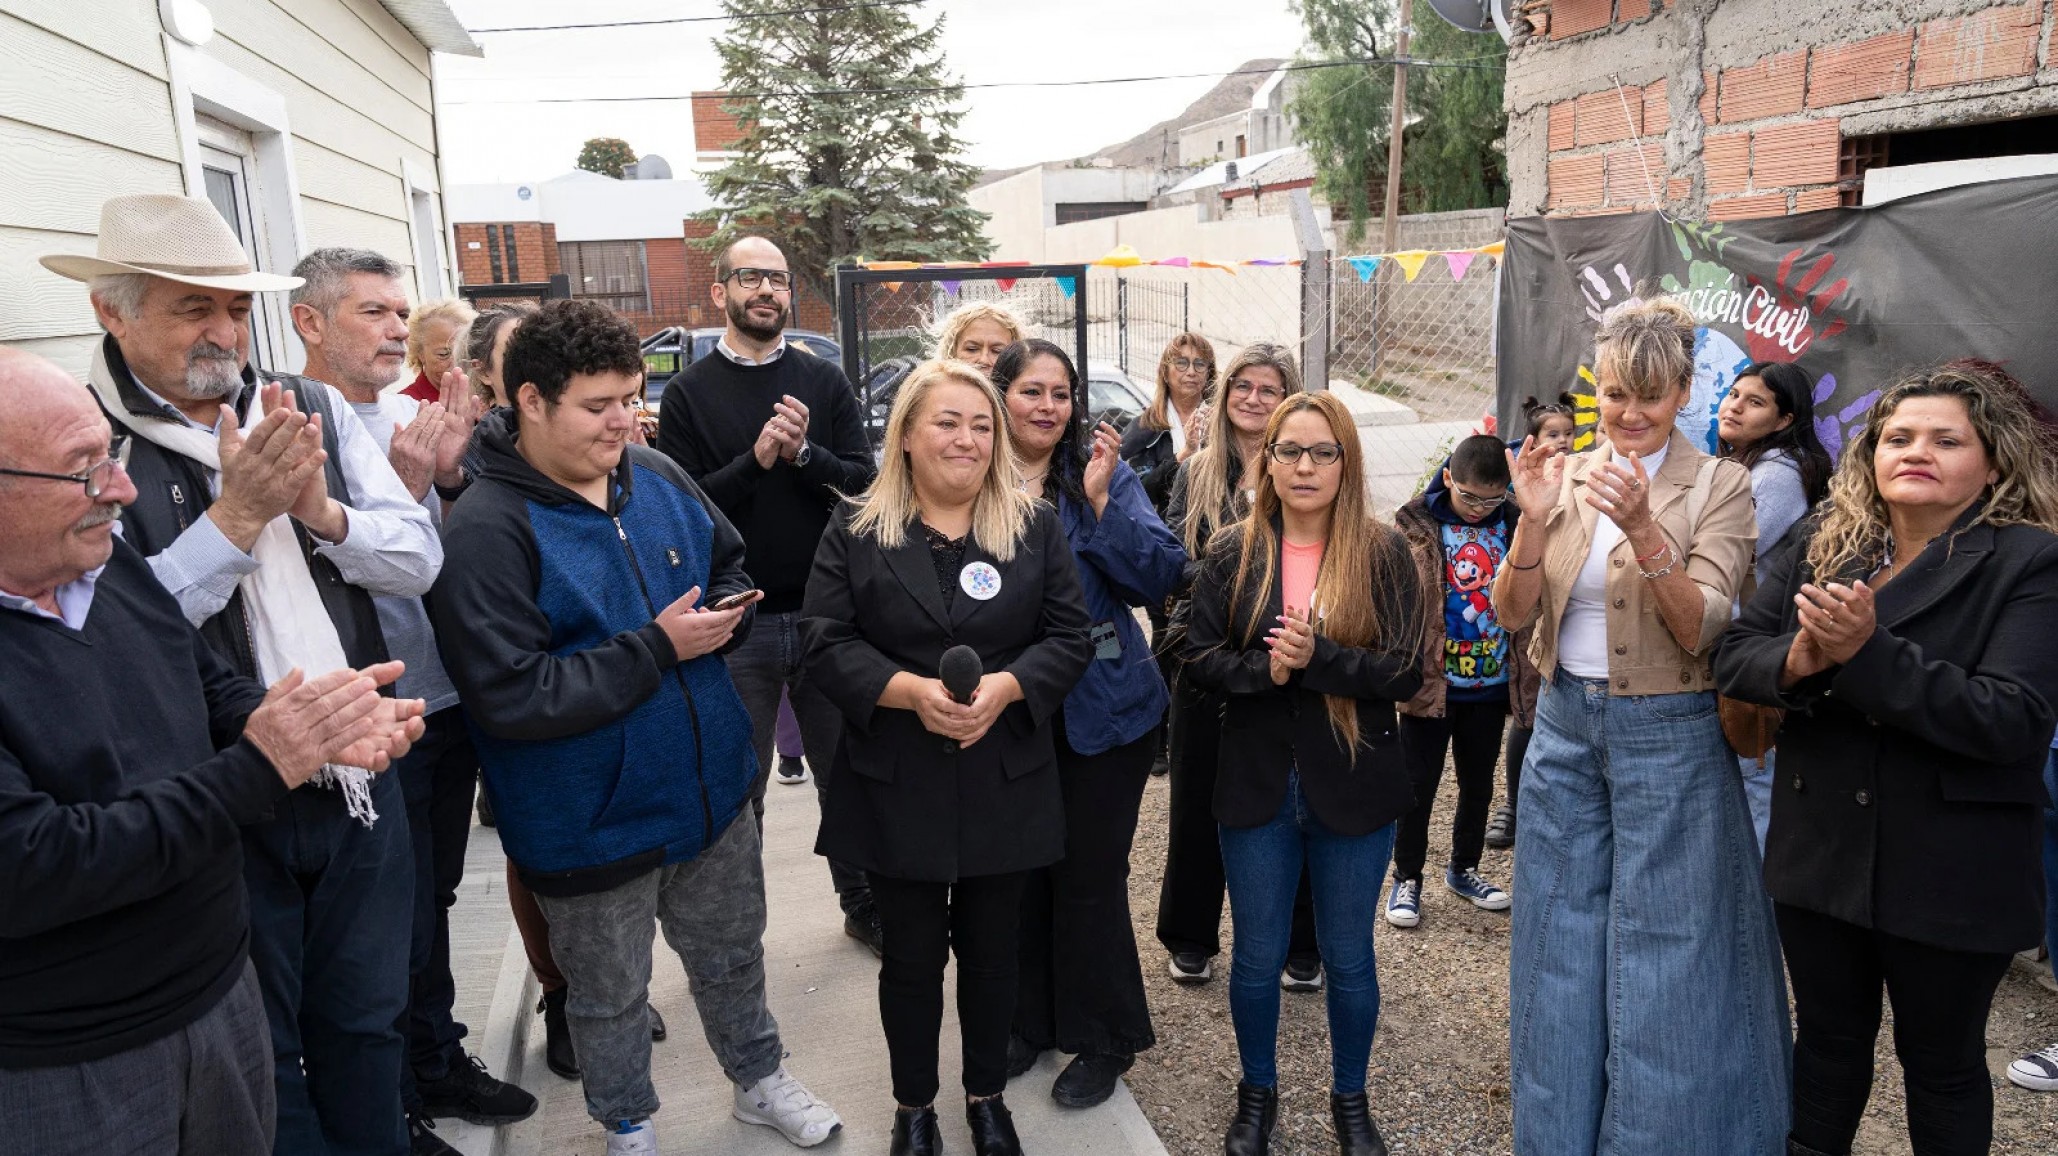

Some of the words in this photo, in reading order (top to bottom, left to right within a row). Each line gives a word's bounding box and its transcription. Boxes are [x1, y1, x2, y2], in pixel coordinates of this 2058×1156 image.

[1742, 284, 1811, 355] Civil
[1444, 639, 1498, 656] UPER
[1441, 654, 1498, 677] ARIO
